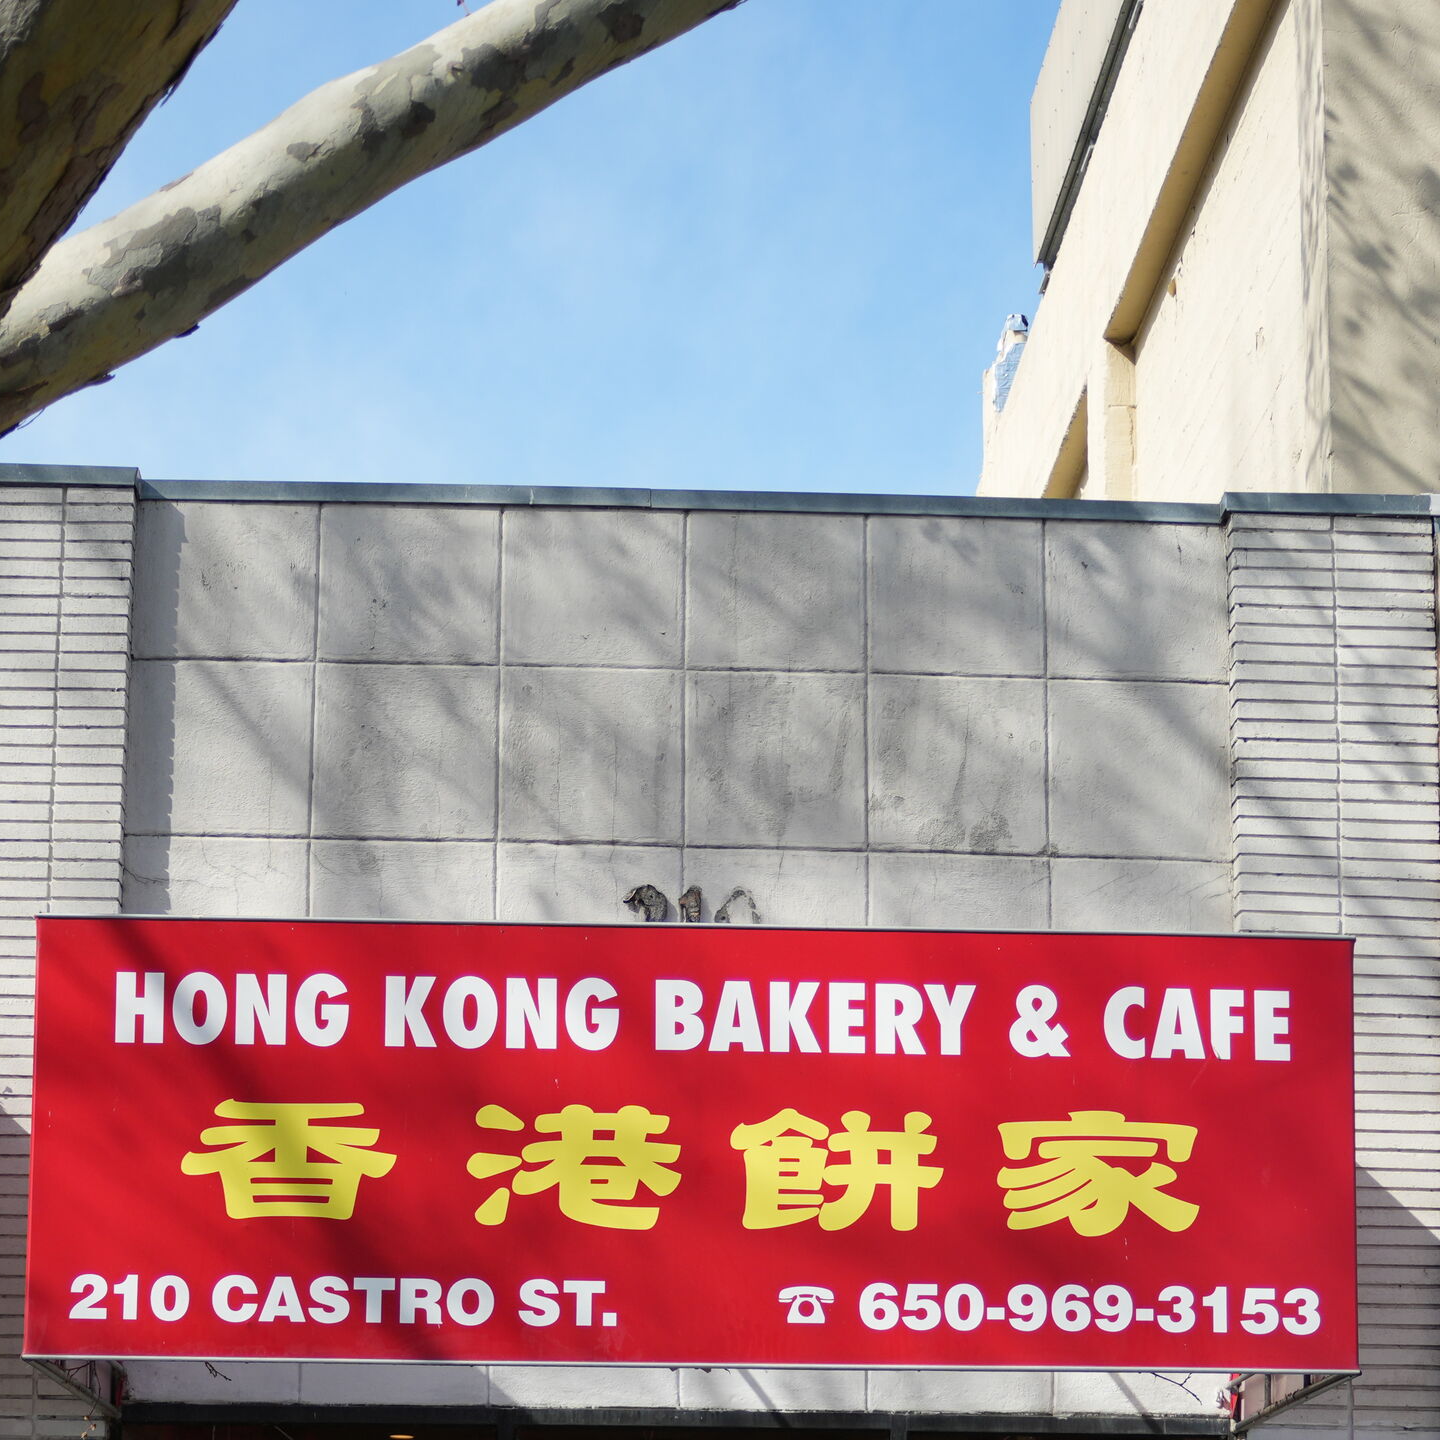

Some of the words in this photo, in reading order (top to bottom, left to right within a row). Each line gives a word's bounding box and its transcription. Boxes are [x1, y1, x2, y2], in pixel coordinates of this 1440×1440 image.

[116, 973, 350, 1048] HONG
[386, 977, 620, 1052] KONG
[657, 981, 977, 1057] BAKERY
[1010, 985, 1071, 1059] &
[1105, 987, 1292, 1062] CAFE
[181, 1098, 1201, 1238] 香港餅家
[70, 1275, 190, 1323] 210
[213, 1276, 495, 1327] CASTRO
[520, 1279, 619, 1328] ST.
[859, 1284, 1322, 1337] 650-969-3153
